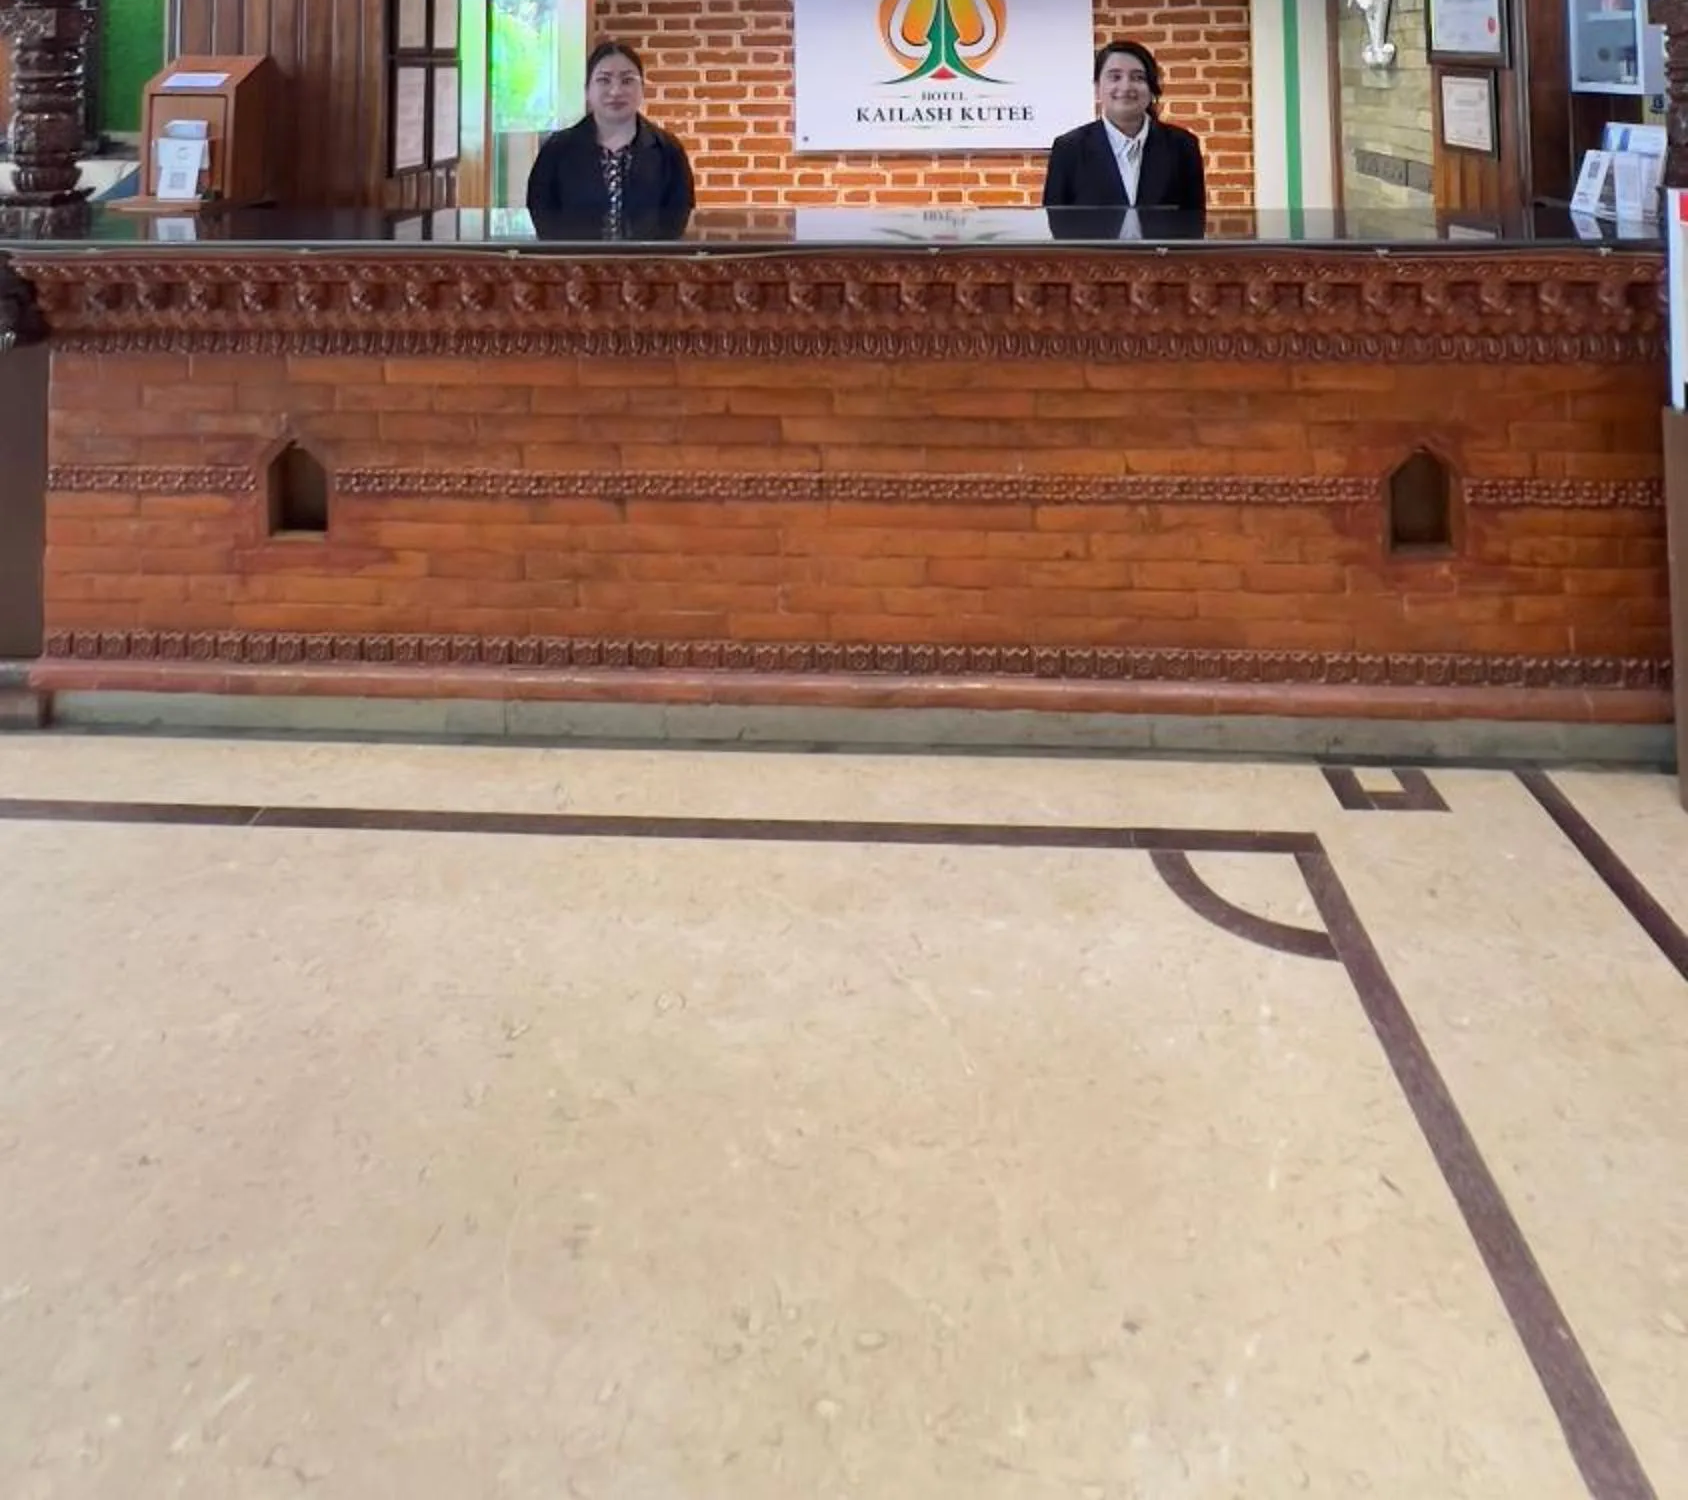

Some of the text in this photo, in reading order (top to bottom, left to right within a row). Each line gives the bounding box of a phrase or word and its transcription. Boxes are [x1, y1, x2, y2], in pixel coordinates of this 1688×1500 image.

[921, 91, 967, 101] HOTEL
[856, 106, 1035, 122] KAILASH KUTEE
